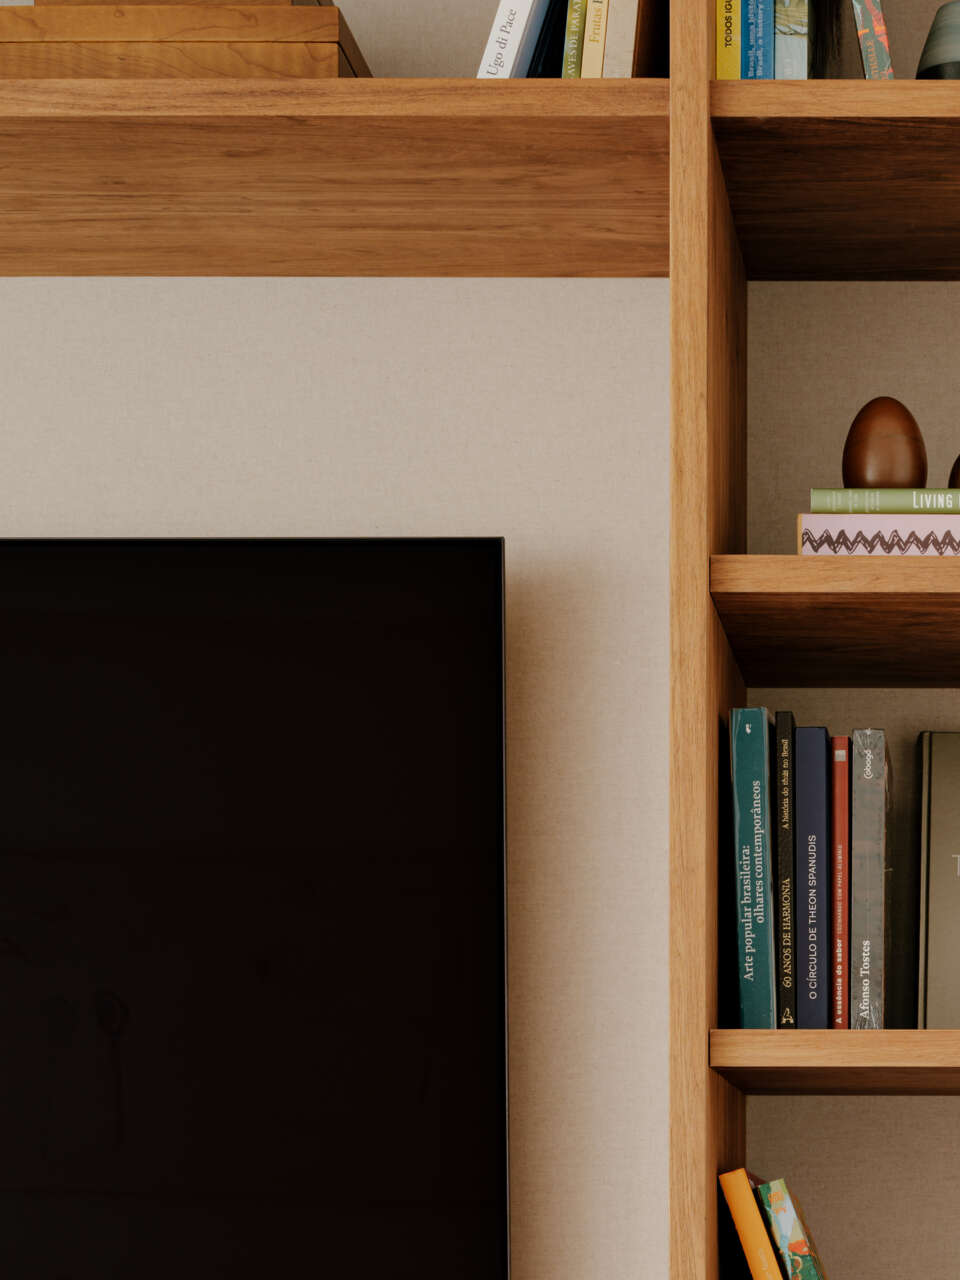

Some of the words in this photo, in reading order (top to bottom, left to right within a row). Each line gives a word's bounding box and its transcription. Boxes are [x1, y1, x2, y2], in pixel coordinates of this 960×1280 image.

[500, 9, 517, 36] Pace
[725, 15, 733, 47] TODOS
[496, 36, 508, 50] di
[569, 32, 580, 49] DE
[487, 52, 503, 76] Ugo
[566, 48, 578, 75] AVES
[913, 491, 953, 508] LIVING
[781, 759, 789, 768] no
[781, 788, 789, 797] do
[781, 798, 789, 823] história
[750, 780, 766, 878] contemporâneos
[740, 844, 753, 904] brasileira:
[808, 835, 817, 887] SPANUDIS
[753, 880, 765, 924] olhares
[781, 878, 792, 931] HARMONIA
[808, 889, 817, 925] THEON
[741, 907, 757, 953] popular
[782, 933, 792, 946] DE
[809, 928, 817, 941] DE
[782, 949, 792, 975] ANOS
[834, 938, 843, 963] sabor
[859, 940, 870, 977] Tostes
[741, 956, 754, 981] Arte
[806, 943, 817, 990] CÍRCULO
[835, 964, 843, 974] do
[782, 977, 793, 988] 60
[809, 991, 817, 1000] O
[834, 977, 843, 1015] essência
[859, 979, 871, 1020] Afonso
